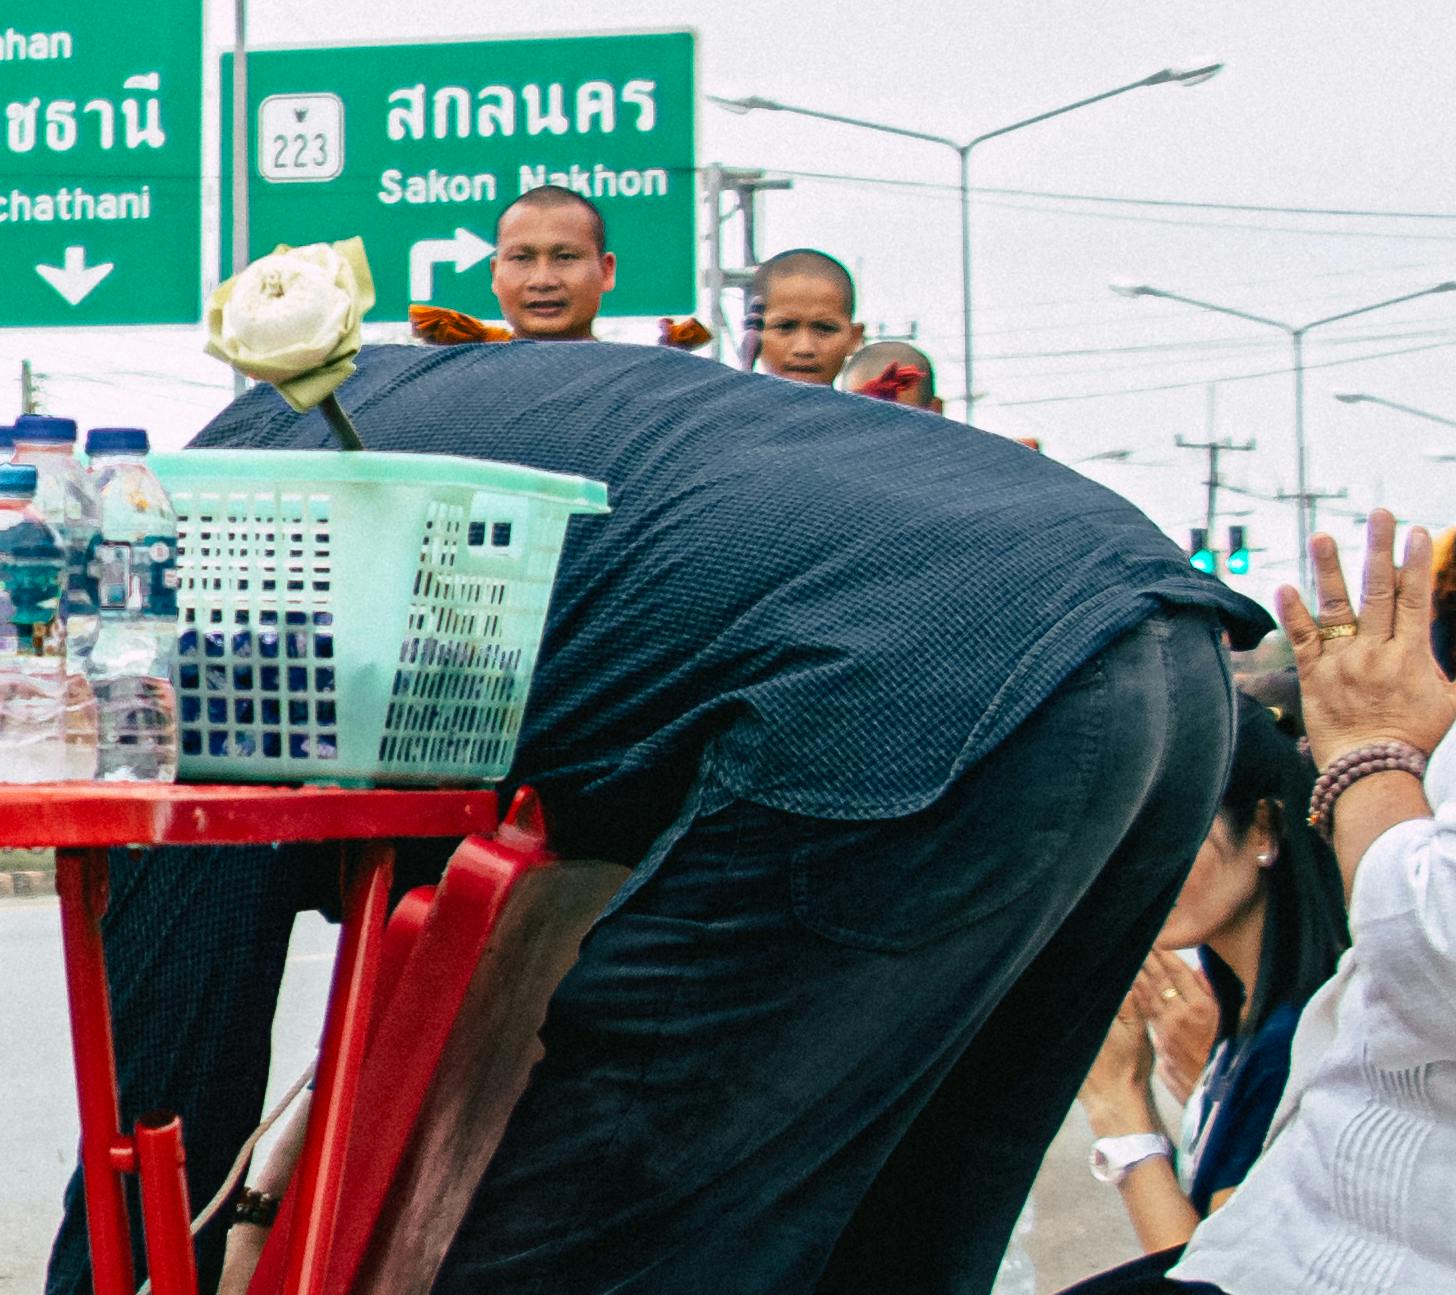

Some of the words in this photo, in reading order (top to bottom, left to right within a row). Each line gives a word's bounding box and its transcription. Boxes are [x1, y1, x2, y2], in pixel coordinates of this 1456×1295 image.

[388, 78, 657, 141] สกลนคร
[272, 133, 329, 169] 223
[378, 167, 497, 206] Sakon
